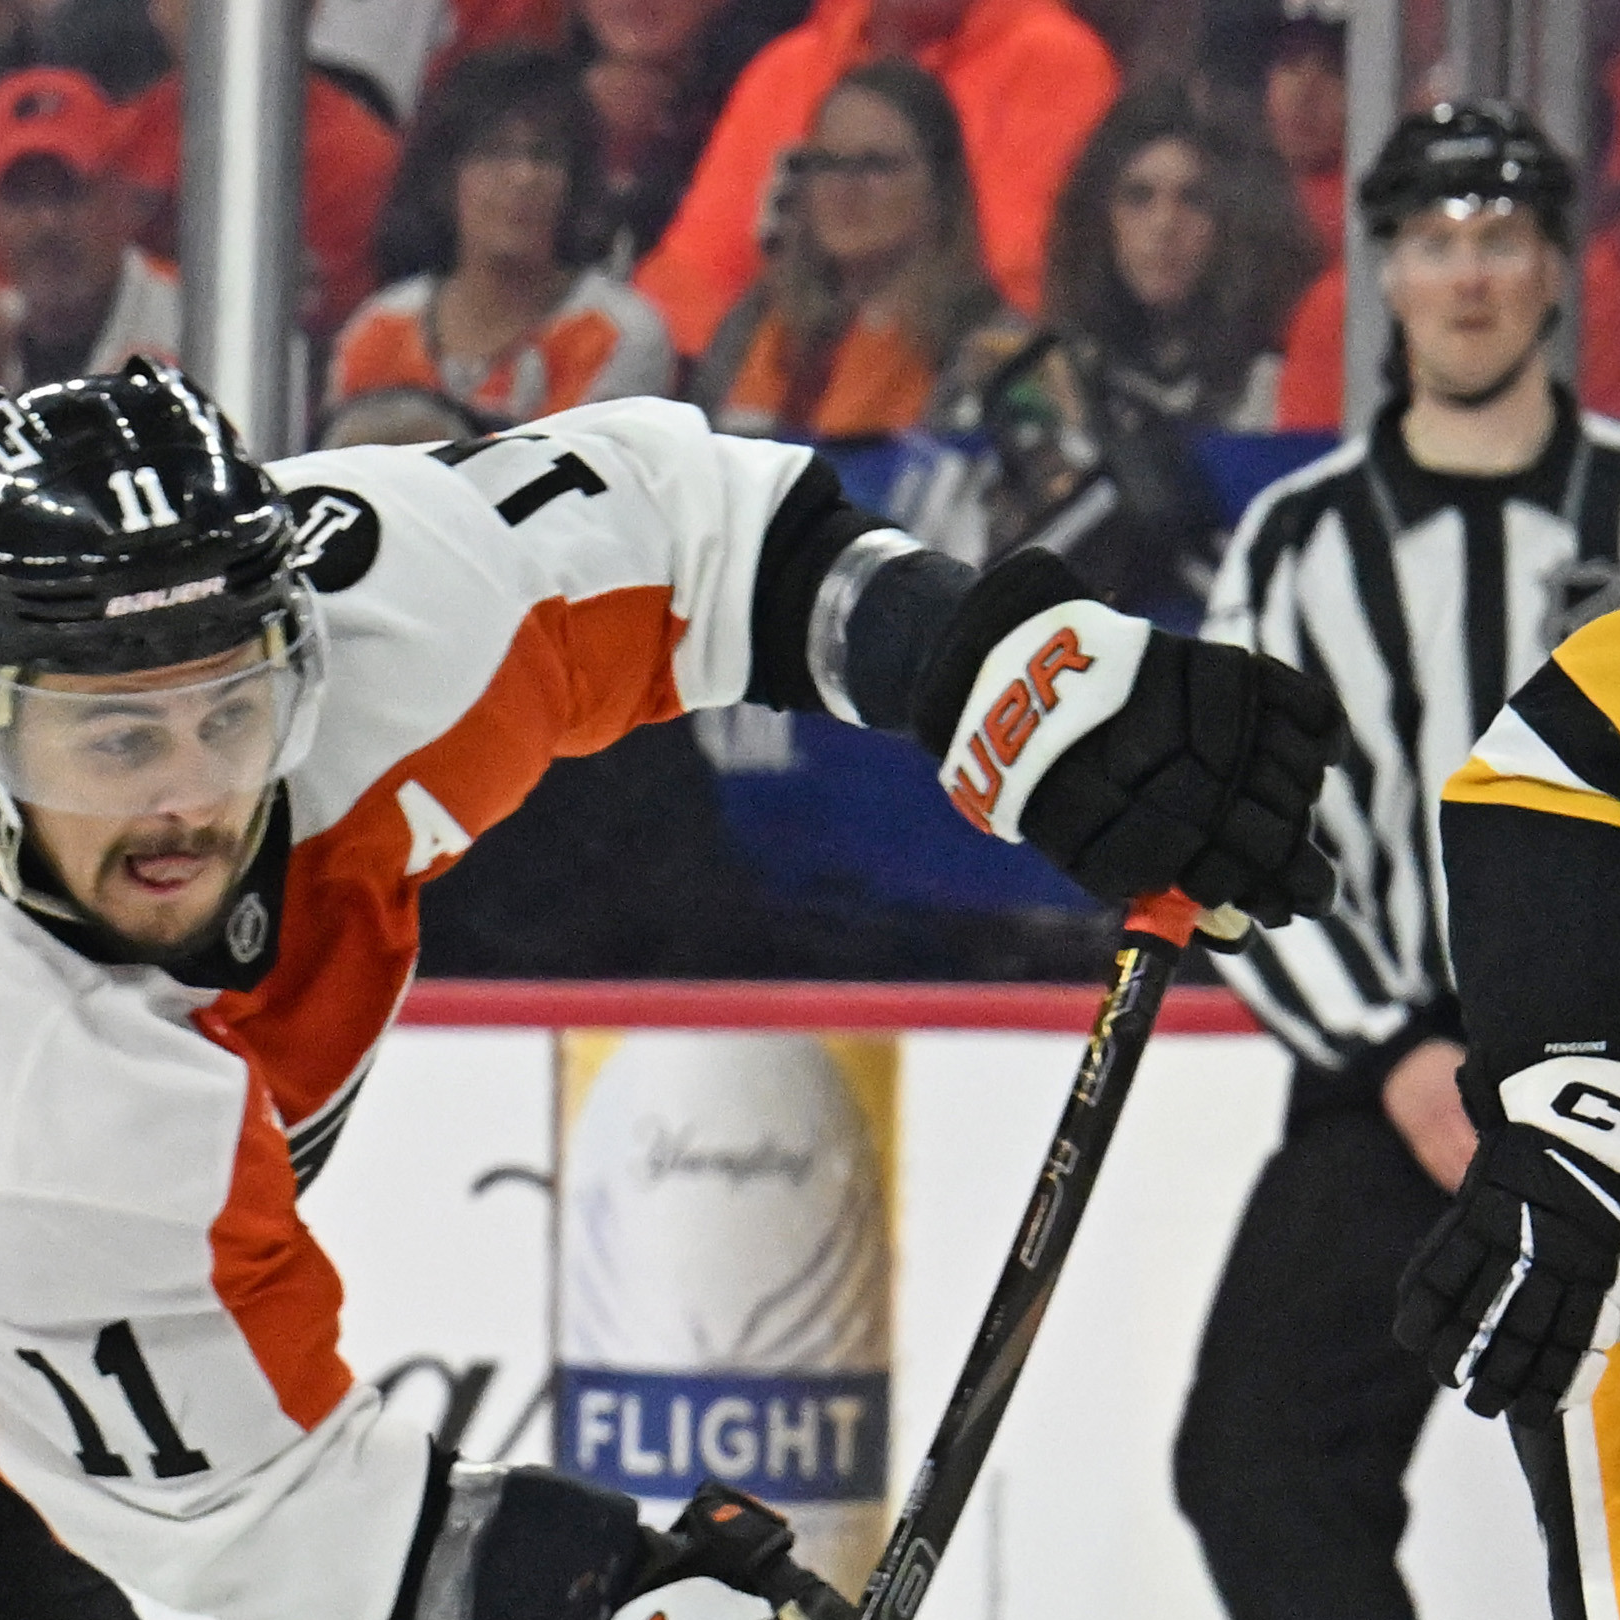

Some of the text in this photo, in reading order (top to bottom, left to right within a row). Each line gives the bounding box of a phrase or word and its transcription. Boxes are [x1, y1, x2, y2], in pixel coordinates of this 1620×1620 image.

[108, 466, 179, 533] 11
[395, 779, 473, 876] A
[15, 1318, 212, 1479] 11
[579, 1390, 869, 1478] FLIGHT
